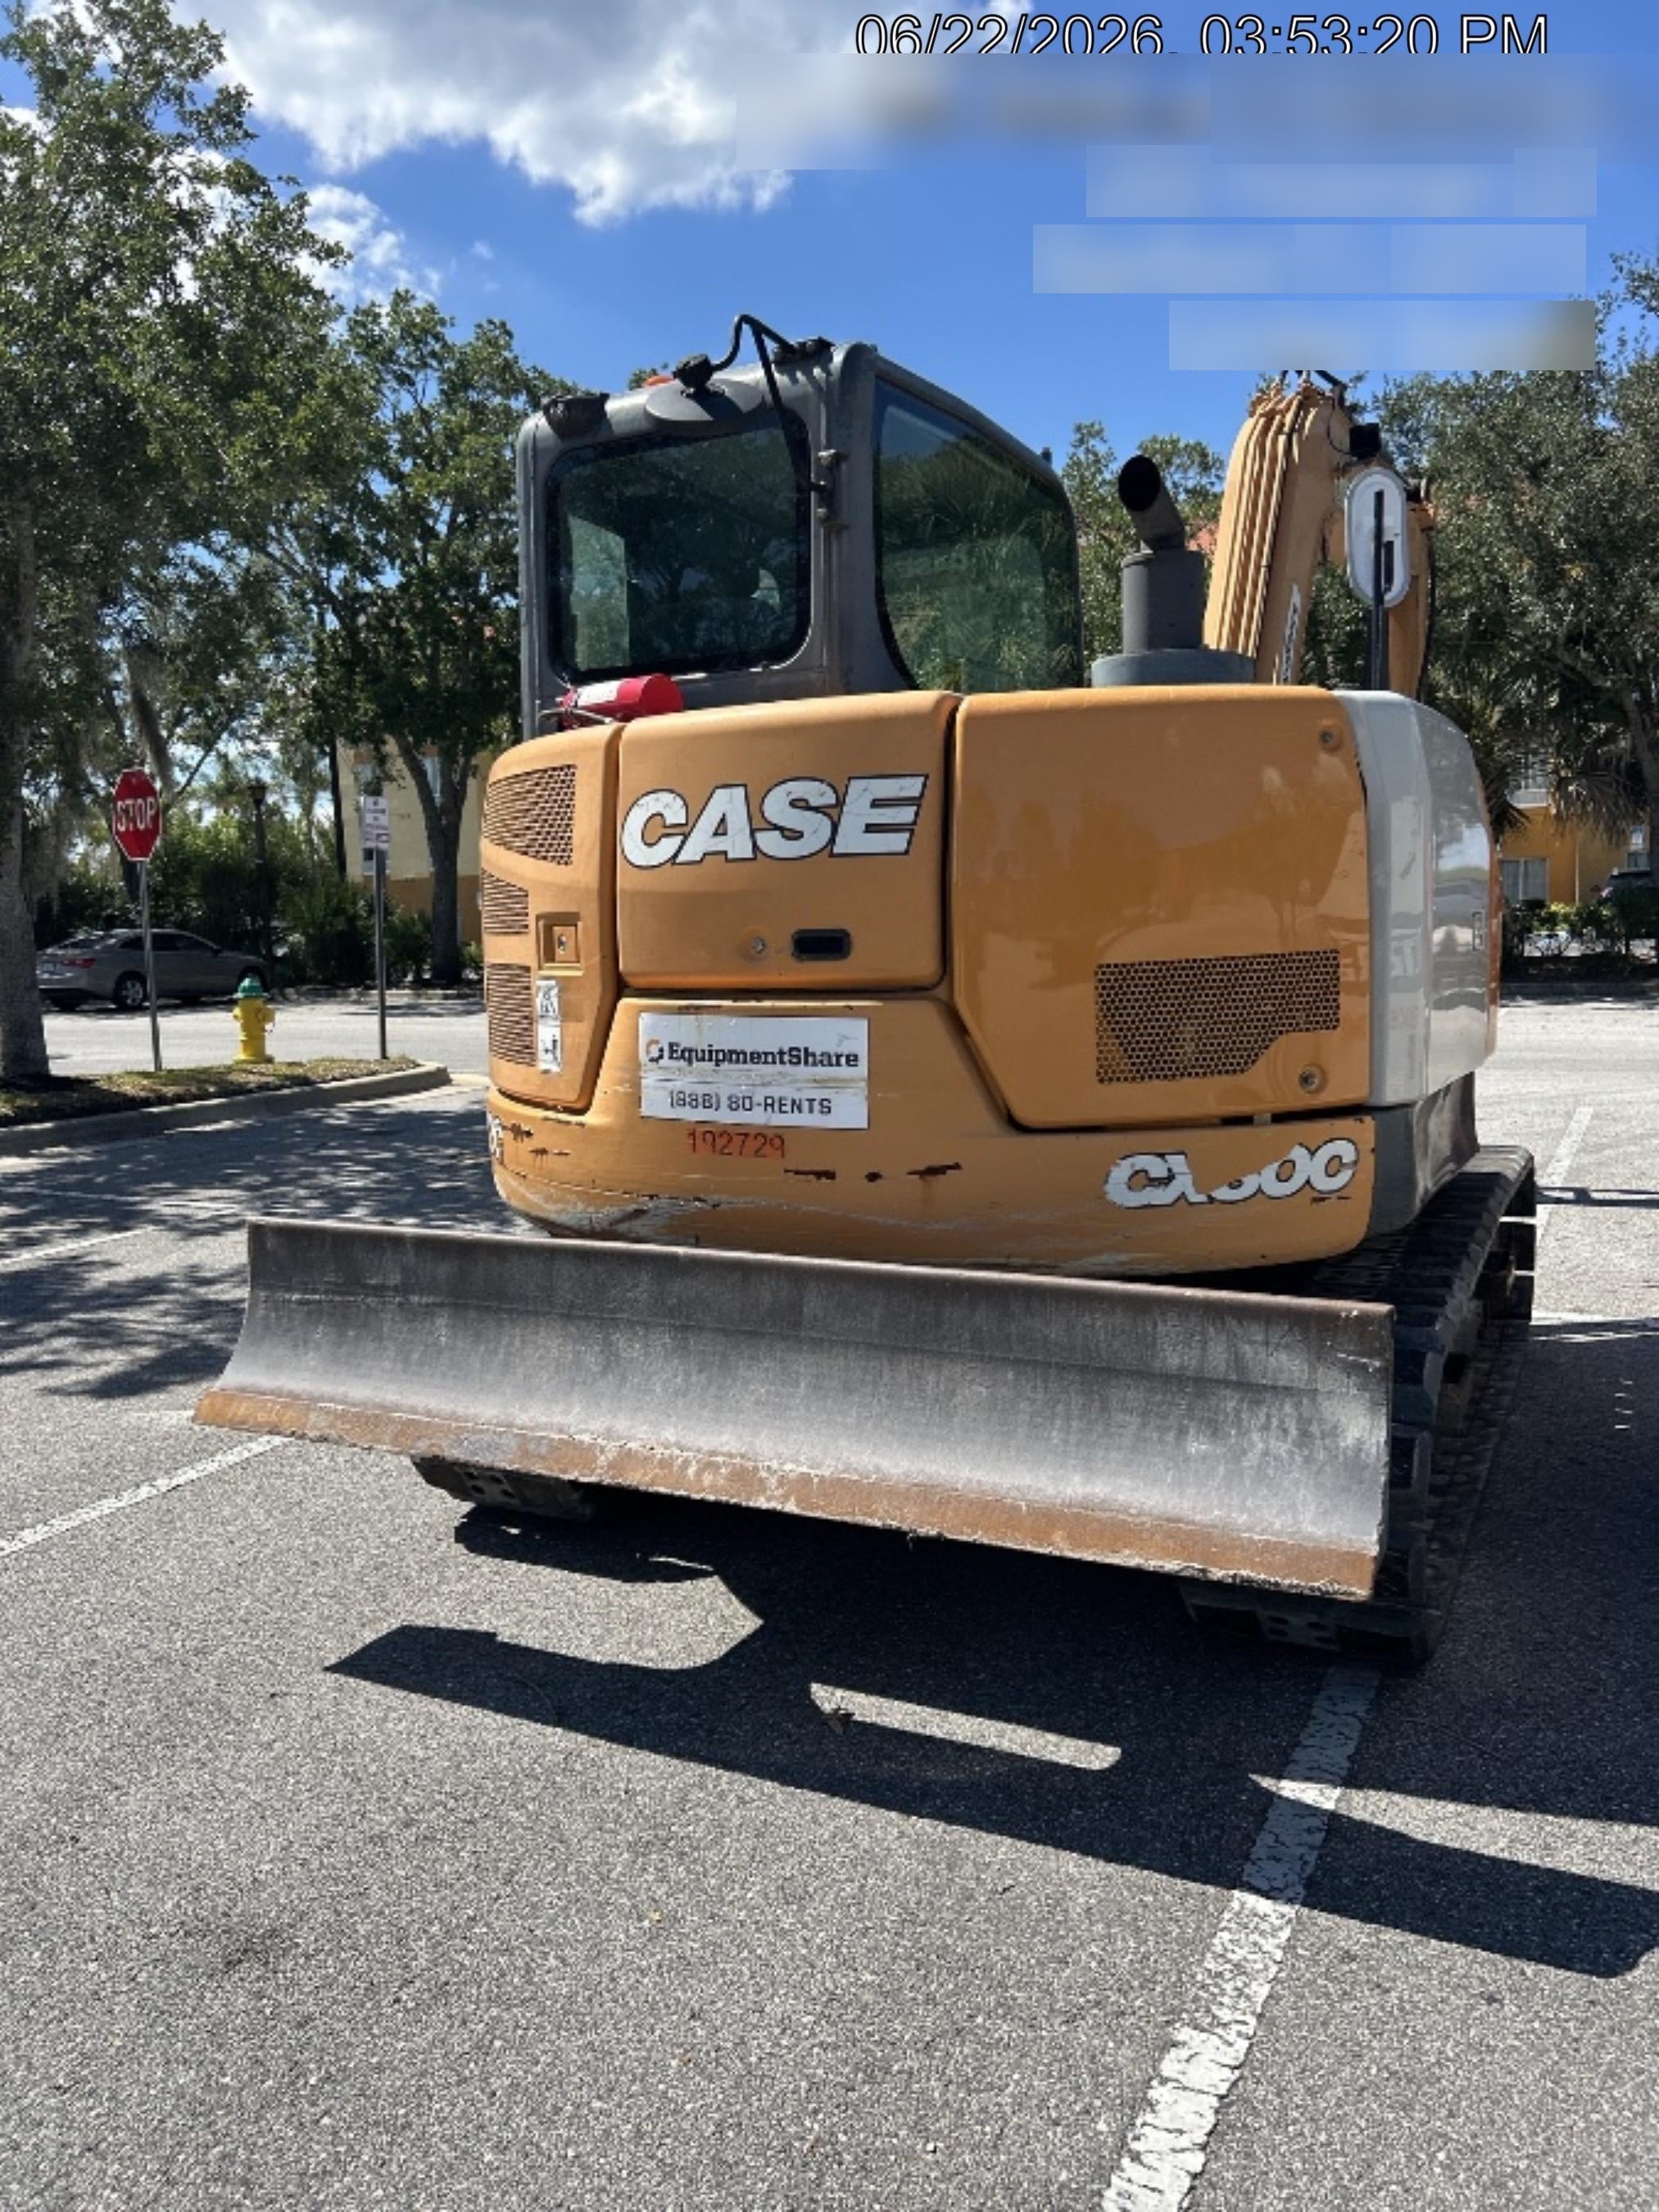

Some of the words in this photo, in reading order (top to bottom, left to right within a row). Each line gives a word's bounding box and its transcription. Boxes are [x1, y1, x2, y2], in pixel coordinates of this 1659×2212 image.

[117, 797, 156, 832] STOP
[620, 774, 929, 870] CASE
[668, 1041, 859, 1067] EquipmentShare
[669, 1090, 720, 1112] (888)
[728, 1095, 832, 1115] 80-RENTS
[687, 1128, 786, 1158] 192729
